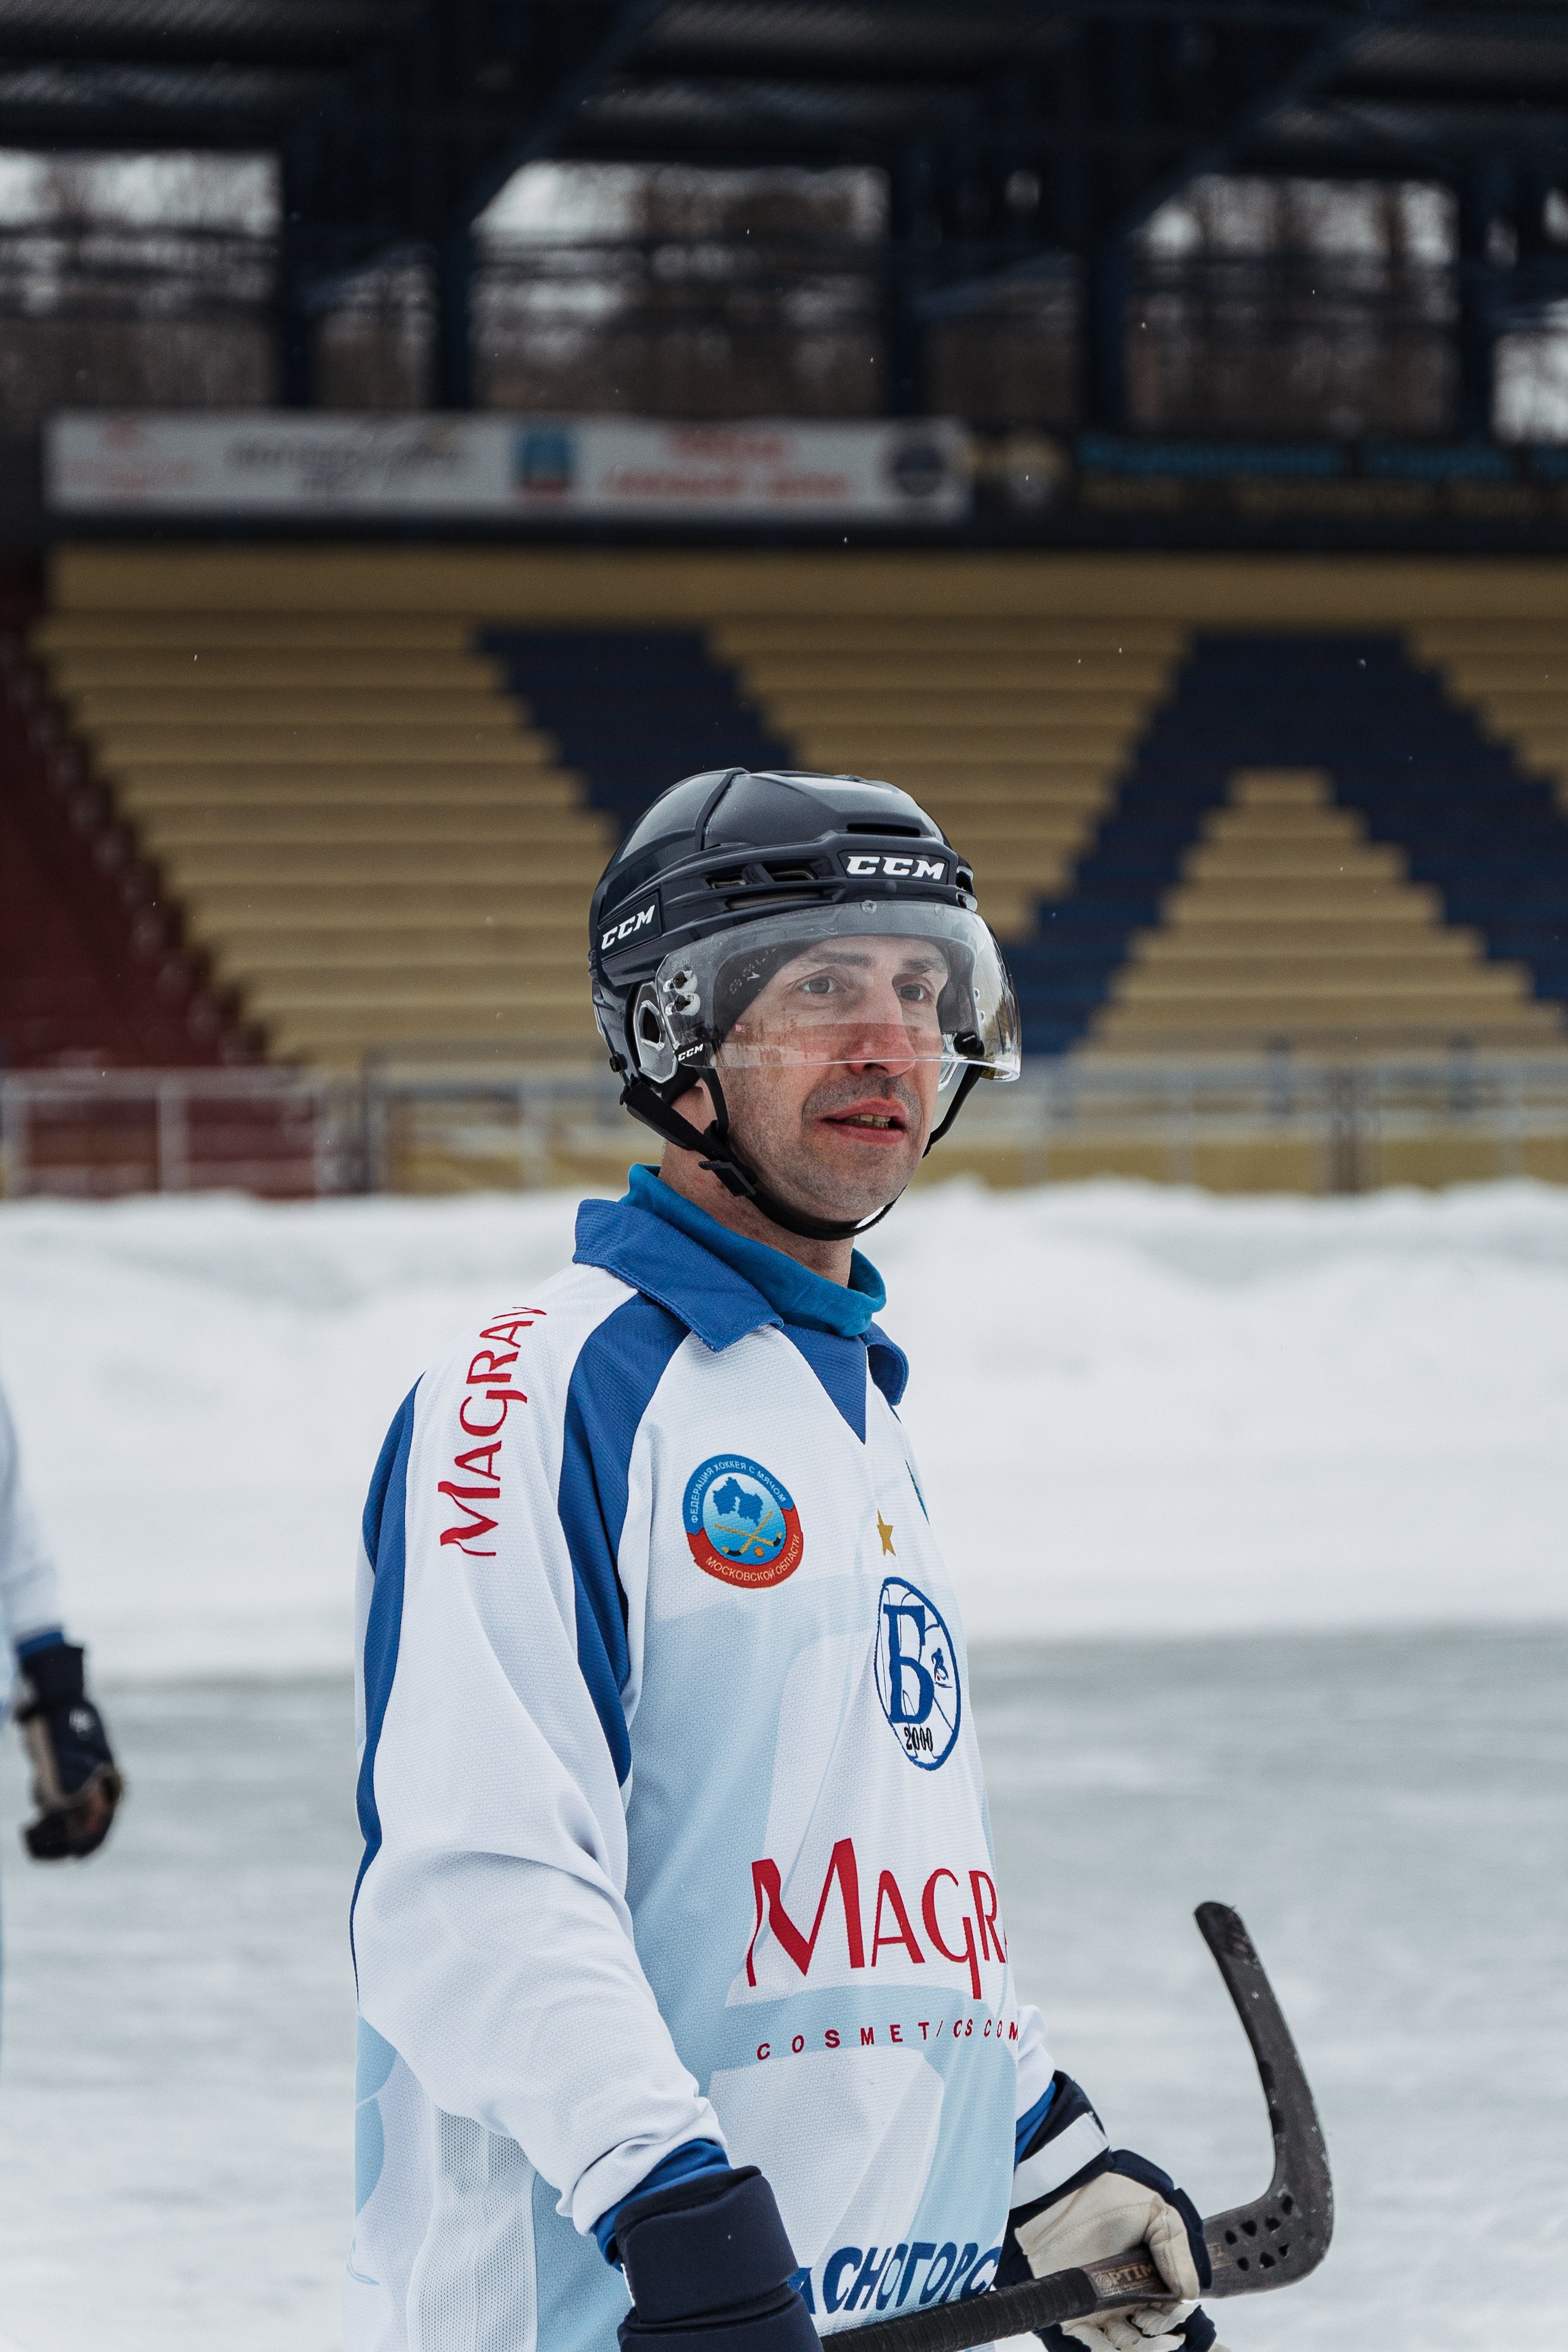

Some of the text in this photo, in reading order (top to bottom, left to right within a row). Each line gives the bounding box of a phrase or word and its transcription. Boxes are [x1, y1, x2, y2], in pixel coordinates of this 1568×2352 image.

[846, 856, 944, 880] CCM
[601, 904, 655, 950] CCM
[678, 1043, 703, 1061] CCM
[691, 1467, 714, 1524] ФЕДЕРАЦИЯ
[713, 1460, 747, 1472] ХОККЕЯ
[756, 1471, 786, 1503] МЯЧОМ
[705, 1534, 800, 1582] МОСКОВСКОЙ ОБЛАСТИ
[903, 1727, 933, 1752] 2000
[746, 1838, 1008, 1999] MAGR
[756, 2018, 973, 2060] COSMETICS
